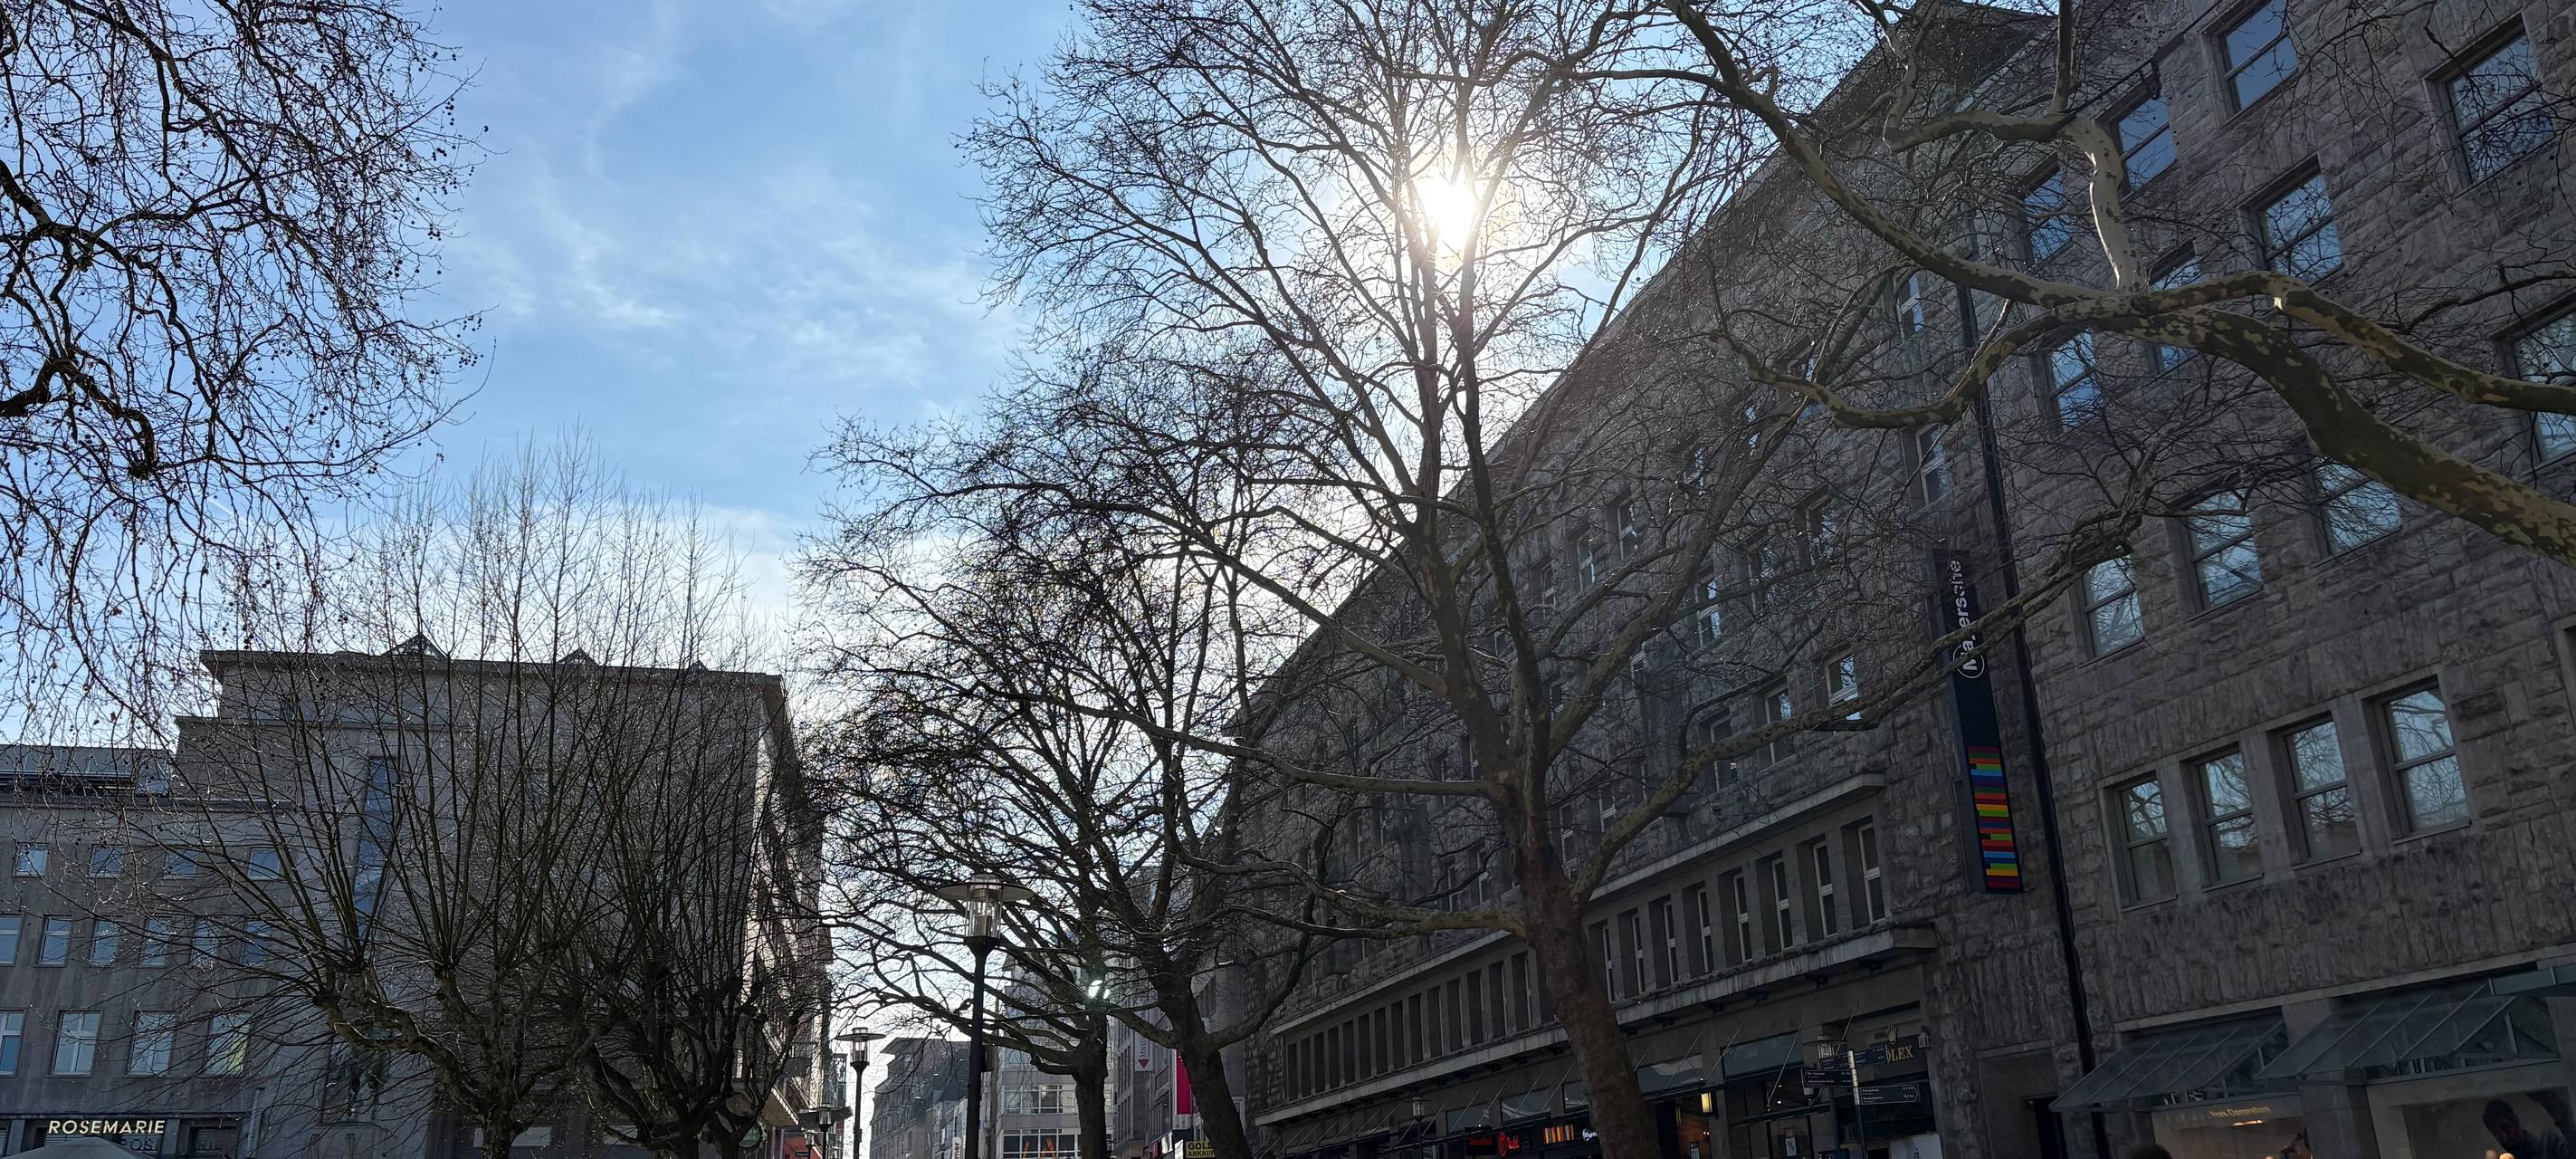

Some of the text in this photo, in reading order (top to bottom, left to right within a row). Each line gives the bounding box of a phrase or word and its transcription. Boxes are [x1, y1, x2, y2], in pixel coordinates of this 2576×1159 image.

[1948, 560, 1979, 672] Maersche
[1887, 1045, 1914, 1062] LEX
[48, 1120, 166, 1135] ROSEMARIE
